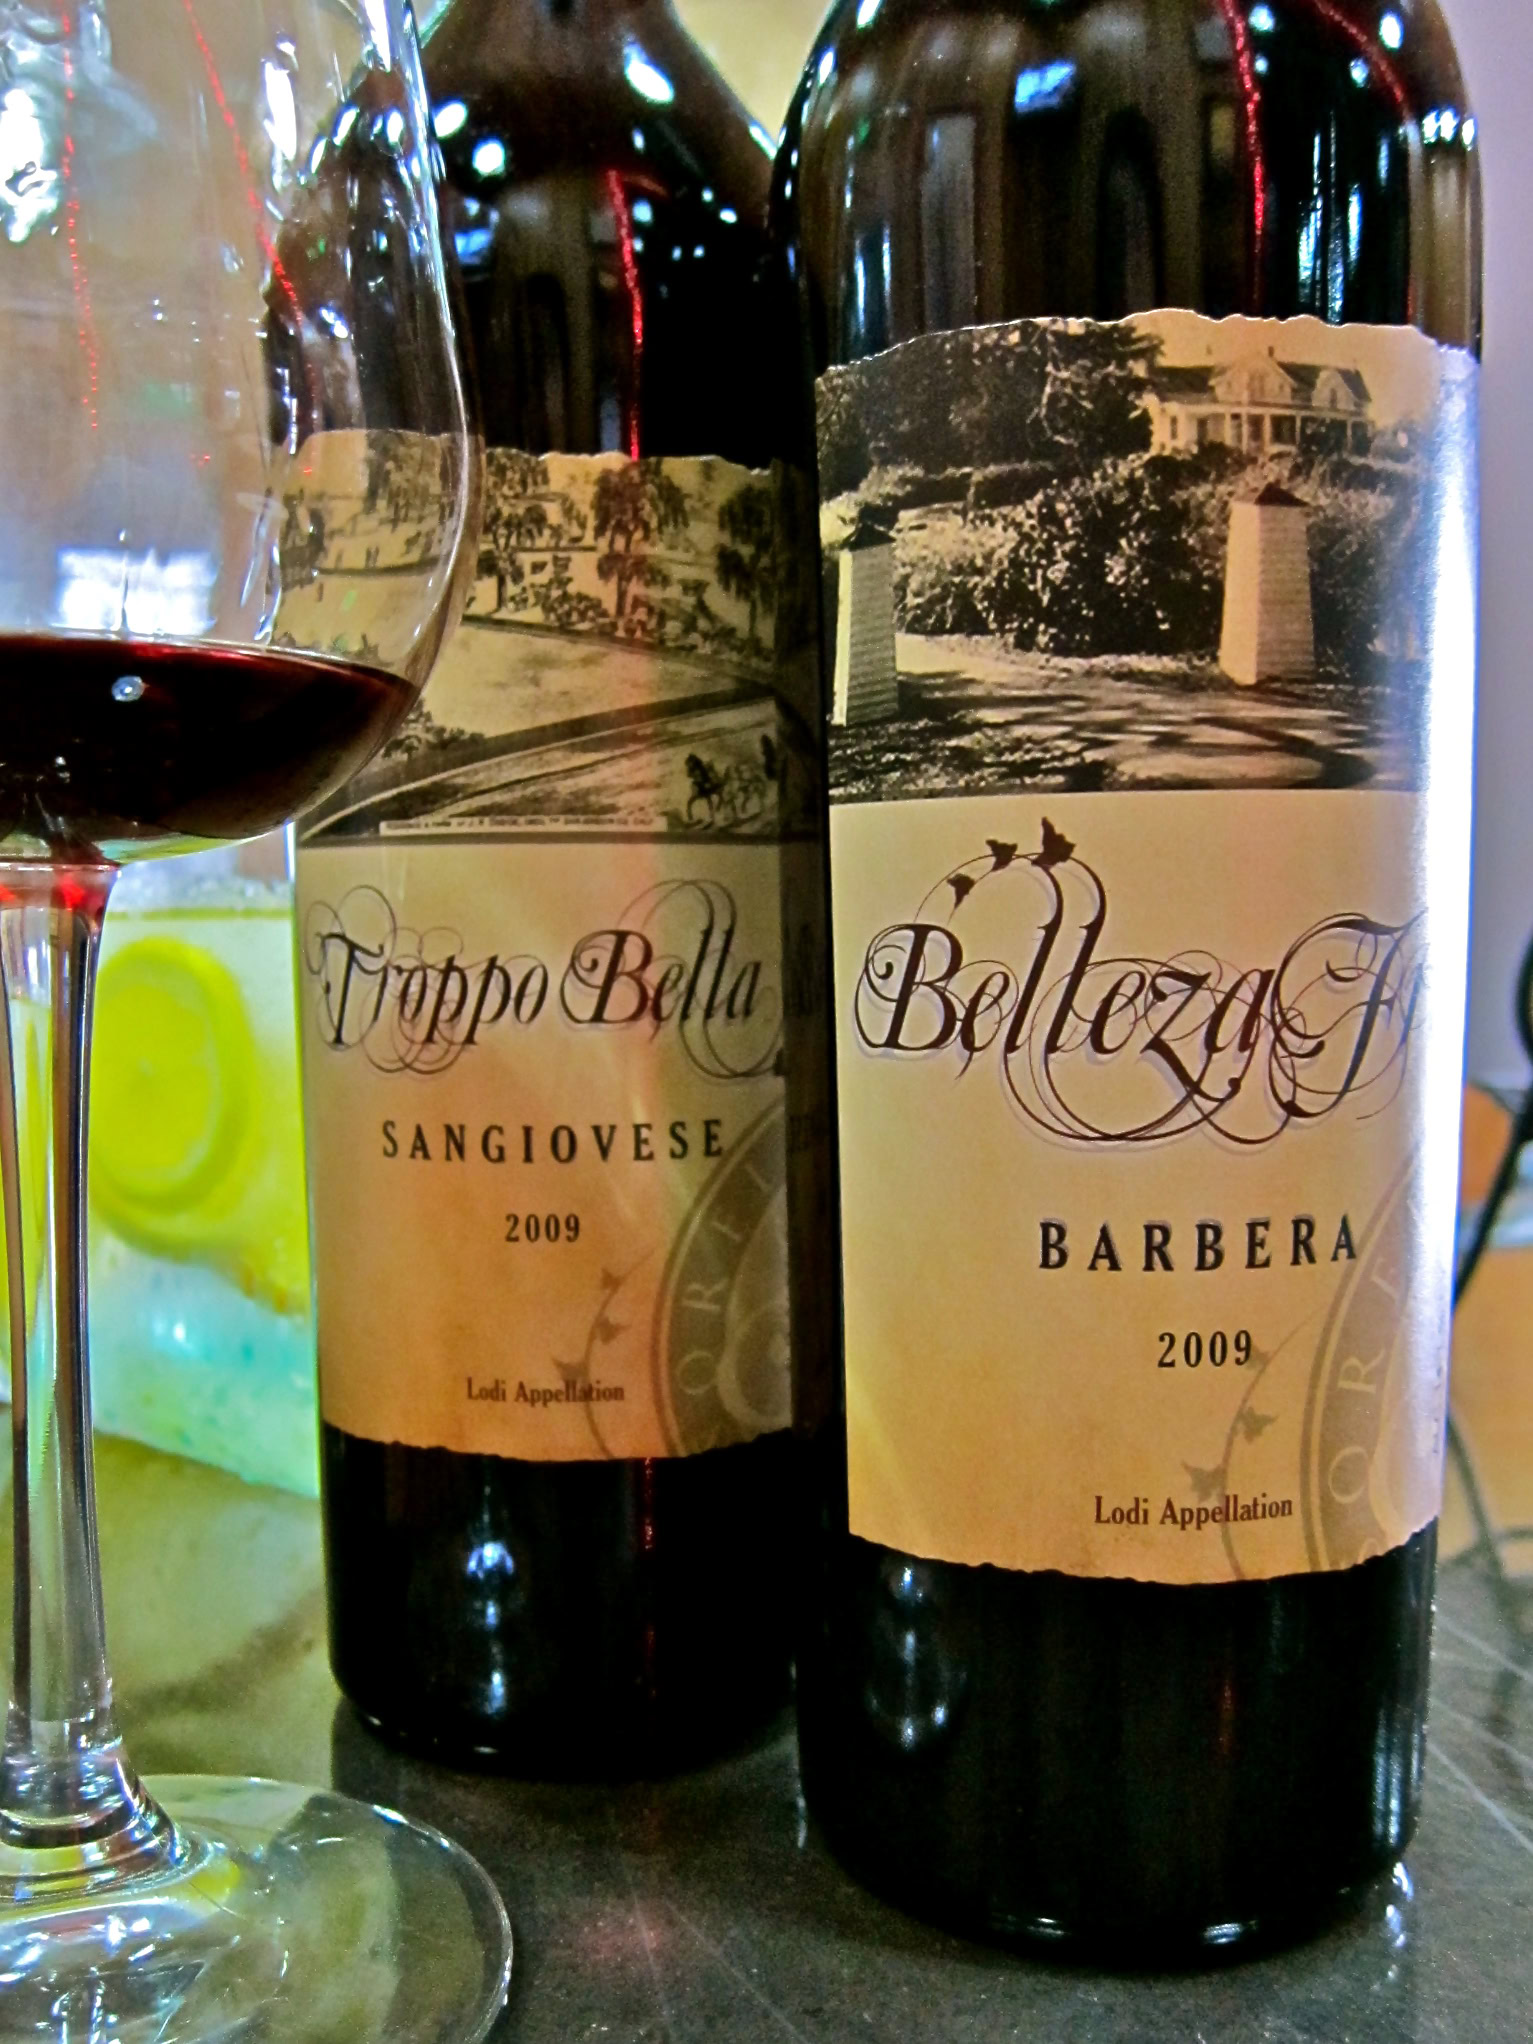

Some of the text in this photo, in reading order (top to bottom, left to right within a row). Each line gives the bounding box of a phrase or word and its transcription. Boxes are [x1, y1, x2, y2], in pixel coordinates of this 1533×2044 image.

[305, 878, 786, 1078] Troppo Bella
[381, 1118, 724, 1165] SANGIOVESE
[505, 1213, 581, 1244] 2009
[1038, 1213, 1358, 1272] BARBERA
[1157, 1329, 1253, 1368] 2009
[466, 1375, 626, 1408] Lodi Appellation
[1094, 1492, 1293, 1531] Lodi Appellation
